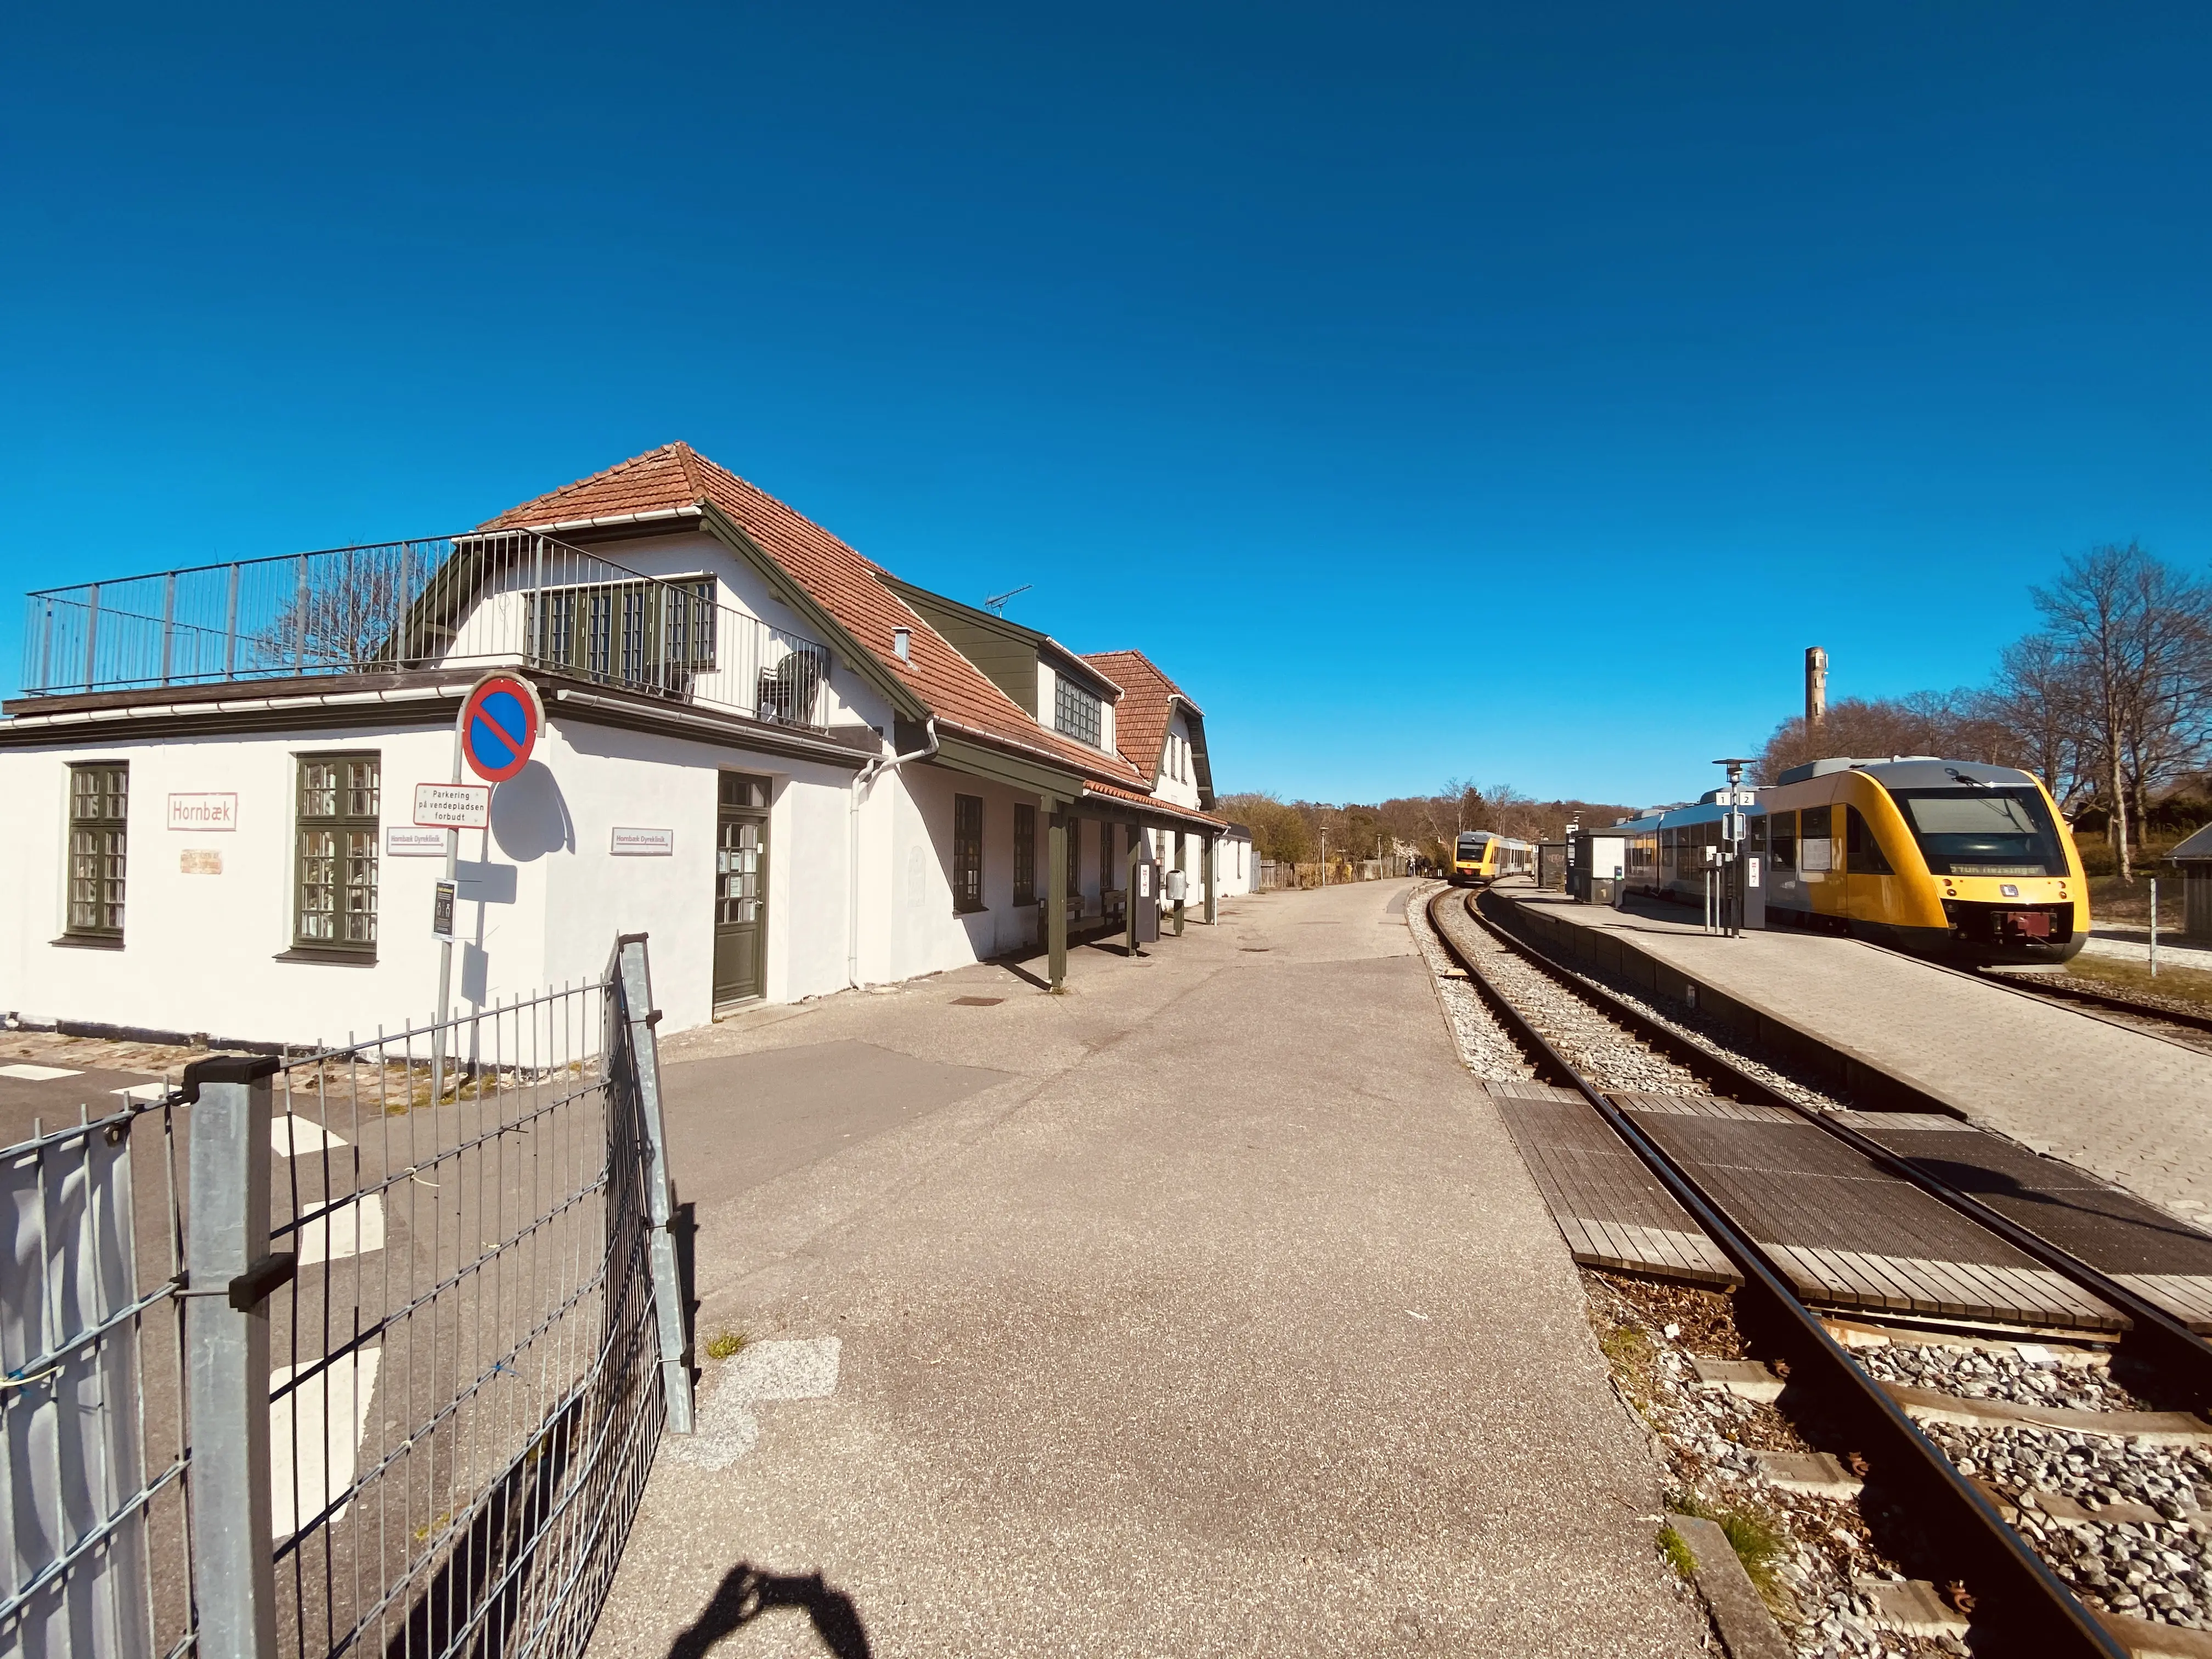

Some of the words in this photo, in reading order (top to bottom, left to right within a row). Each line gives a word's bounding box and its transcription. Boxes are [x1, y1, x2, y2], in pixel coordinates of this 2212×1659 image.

[433, 790, 470, 800] Parkering
[419, 800, 427, 809] på
[430, 802, 484, 811] vendepladsen
[173, 801, 230, 821] Hornbæk
[435, 812, 465, 821] forbudt
[414, 835, 440, 843] Dyreklinik
